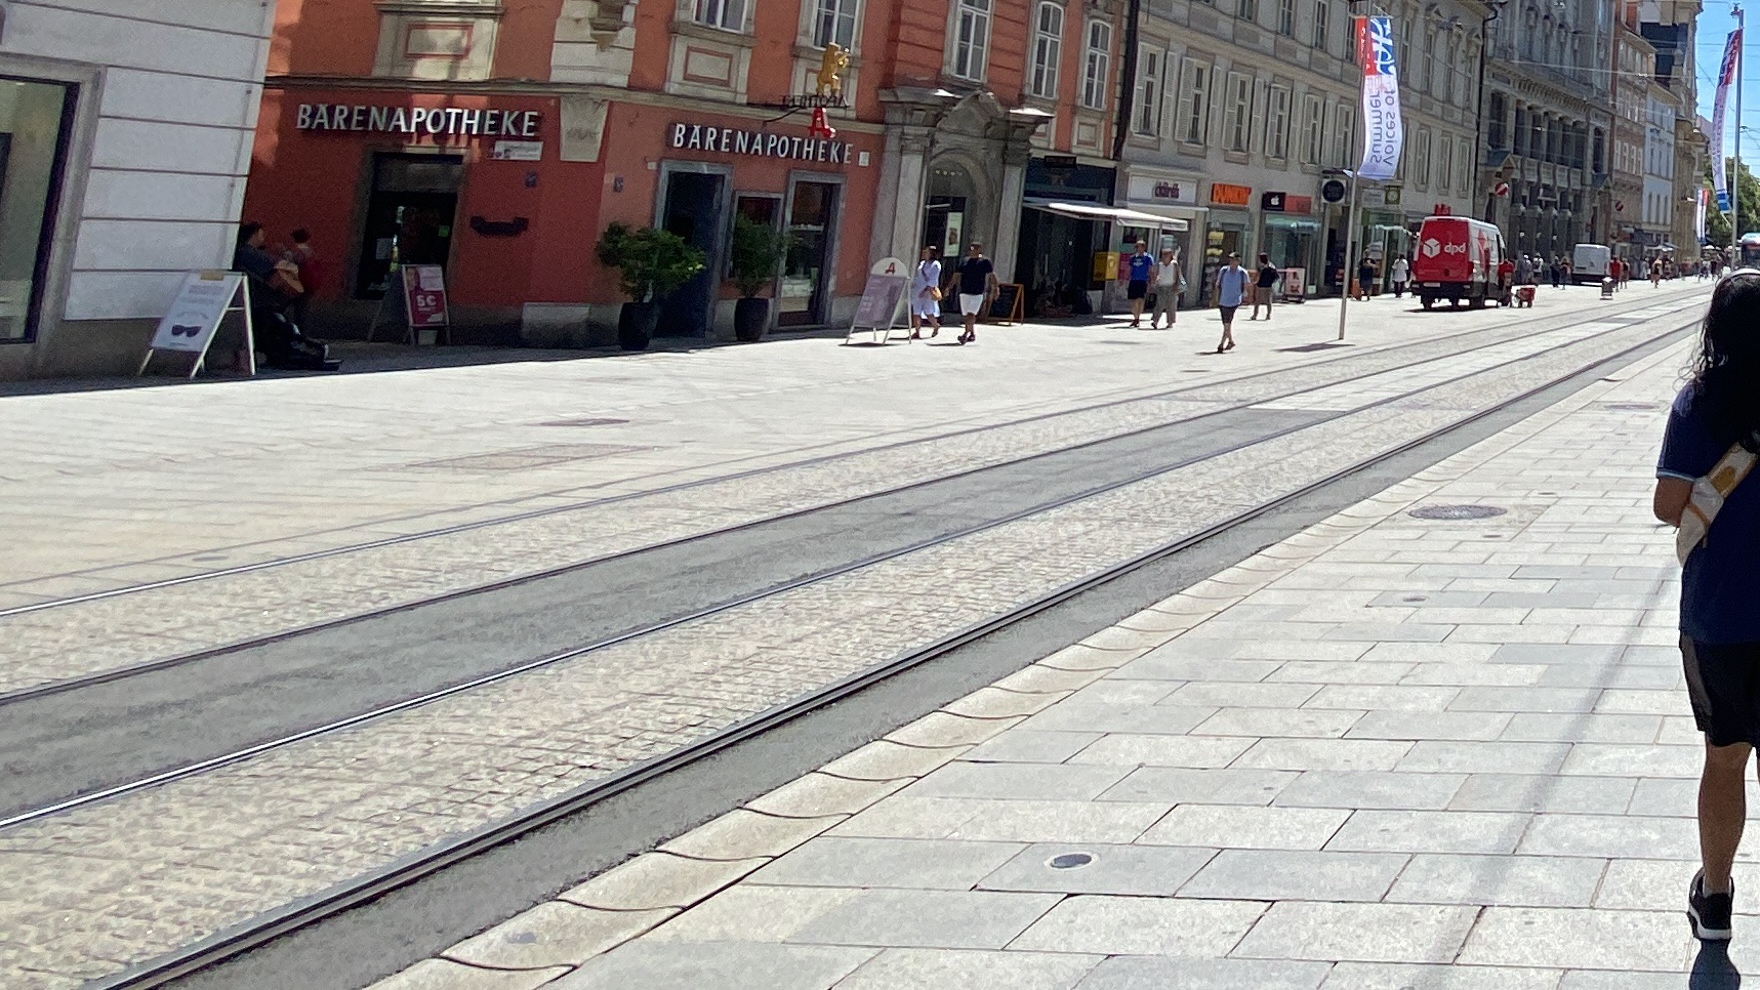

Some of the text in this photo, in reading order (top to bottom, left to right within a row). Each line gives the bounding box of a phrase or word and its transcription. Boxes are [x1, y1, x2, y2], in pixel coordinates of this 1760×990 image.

[296, 103, 539, 137] BÄRENAPOTHEKE
[673, 123, 853, 164] BÄRENAPOTHEKE
[1444, 242, 1466, 255] dpd
